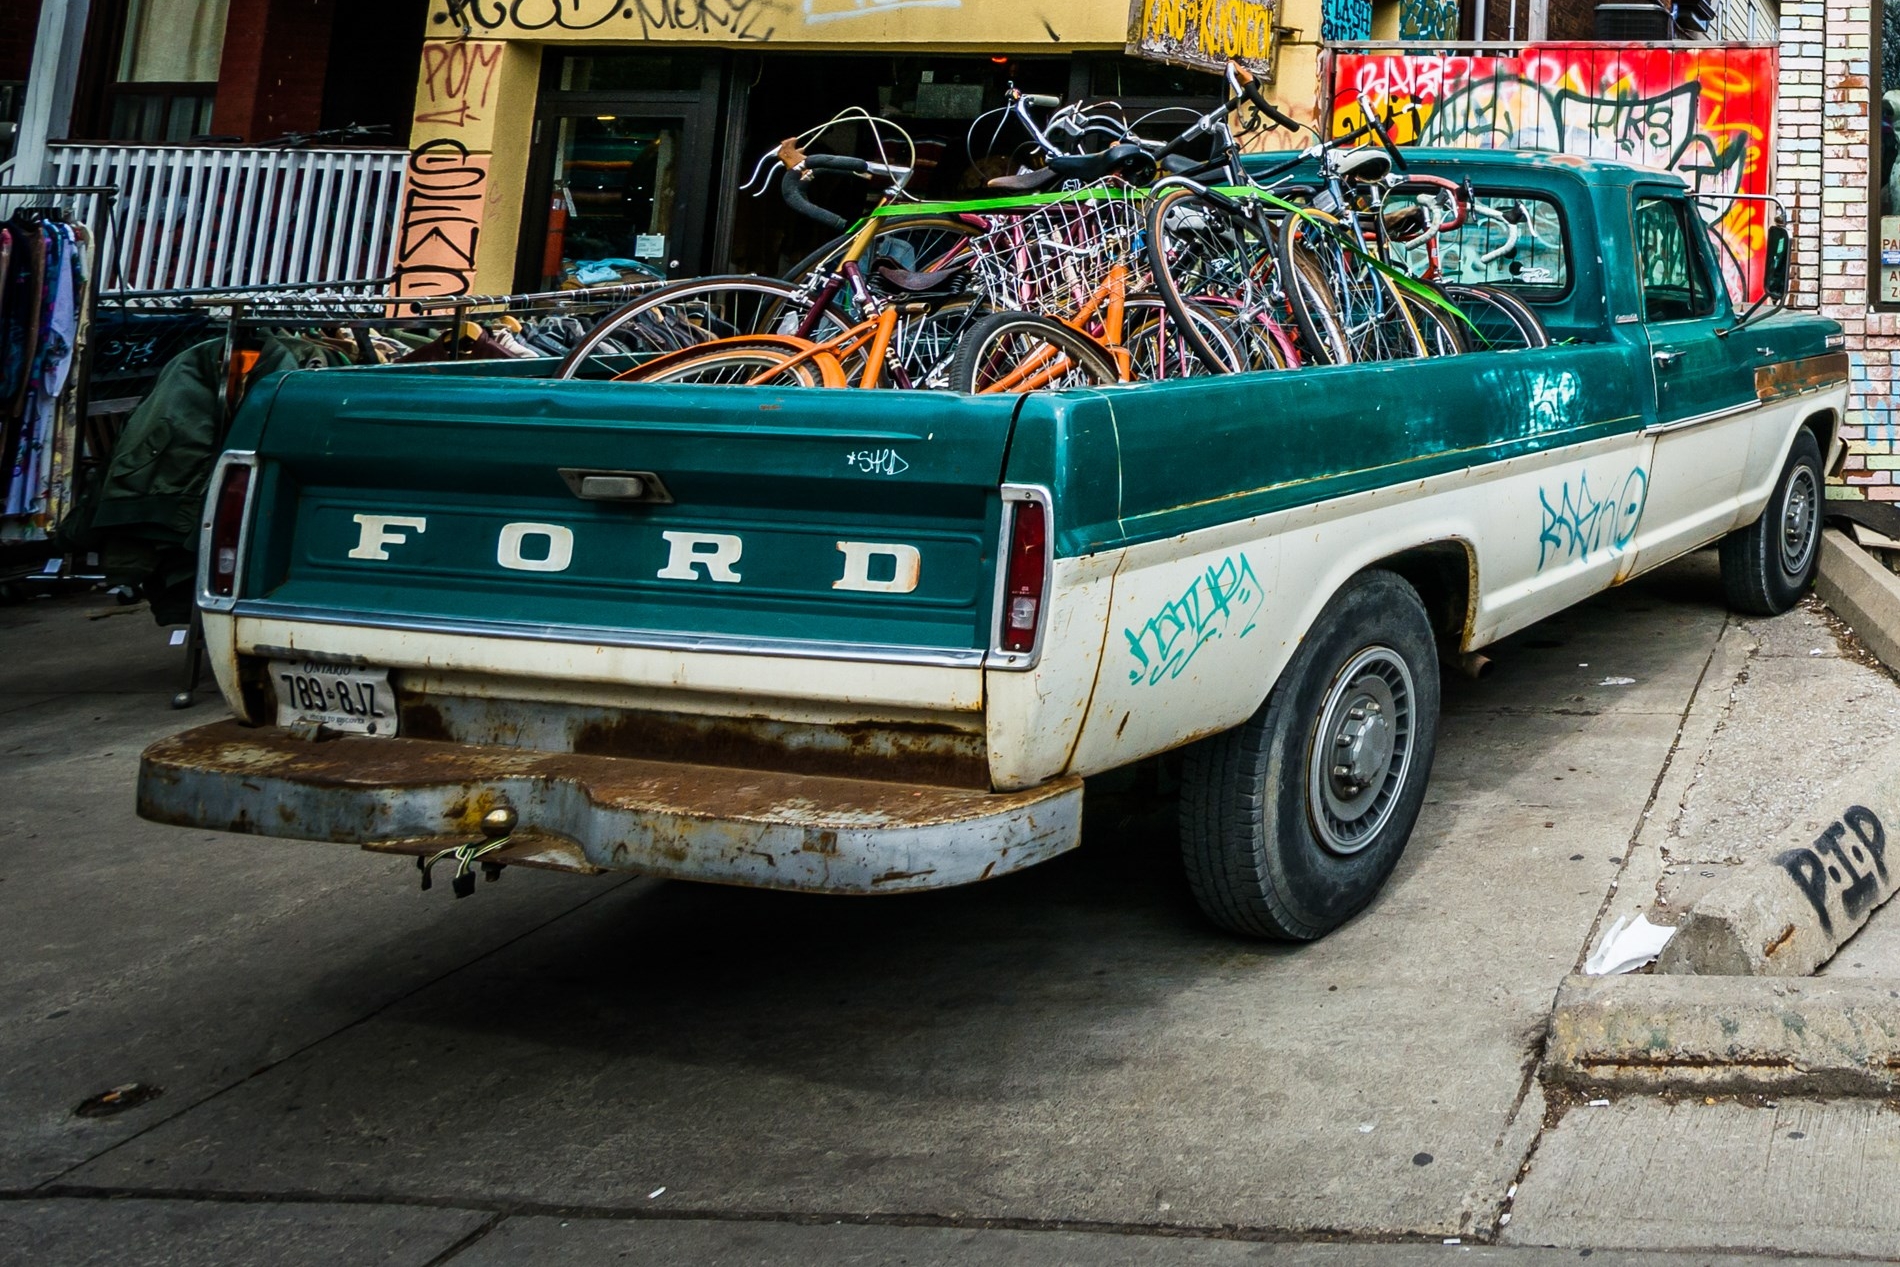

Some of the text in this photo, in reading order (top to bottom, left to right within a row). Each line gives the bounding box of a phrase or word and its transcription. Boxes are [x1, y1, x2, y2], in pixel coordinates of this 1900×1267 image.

[348, 514, 921, 594] FORD
[303, 661, 352, 675] ONTARIO
[281, 674, 328, 712] 789
